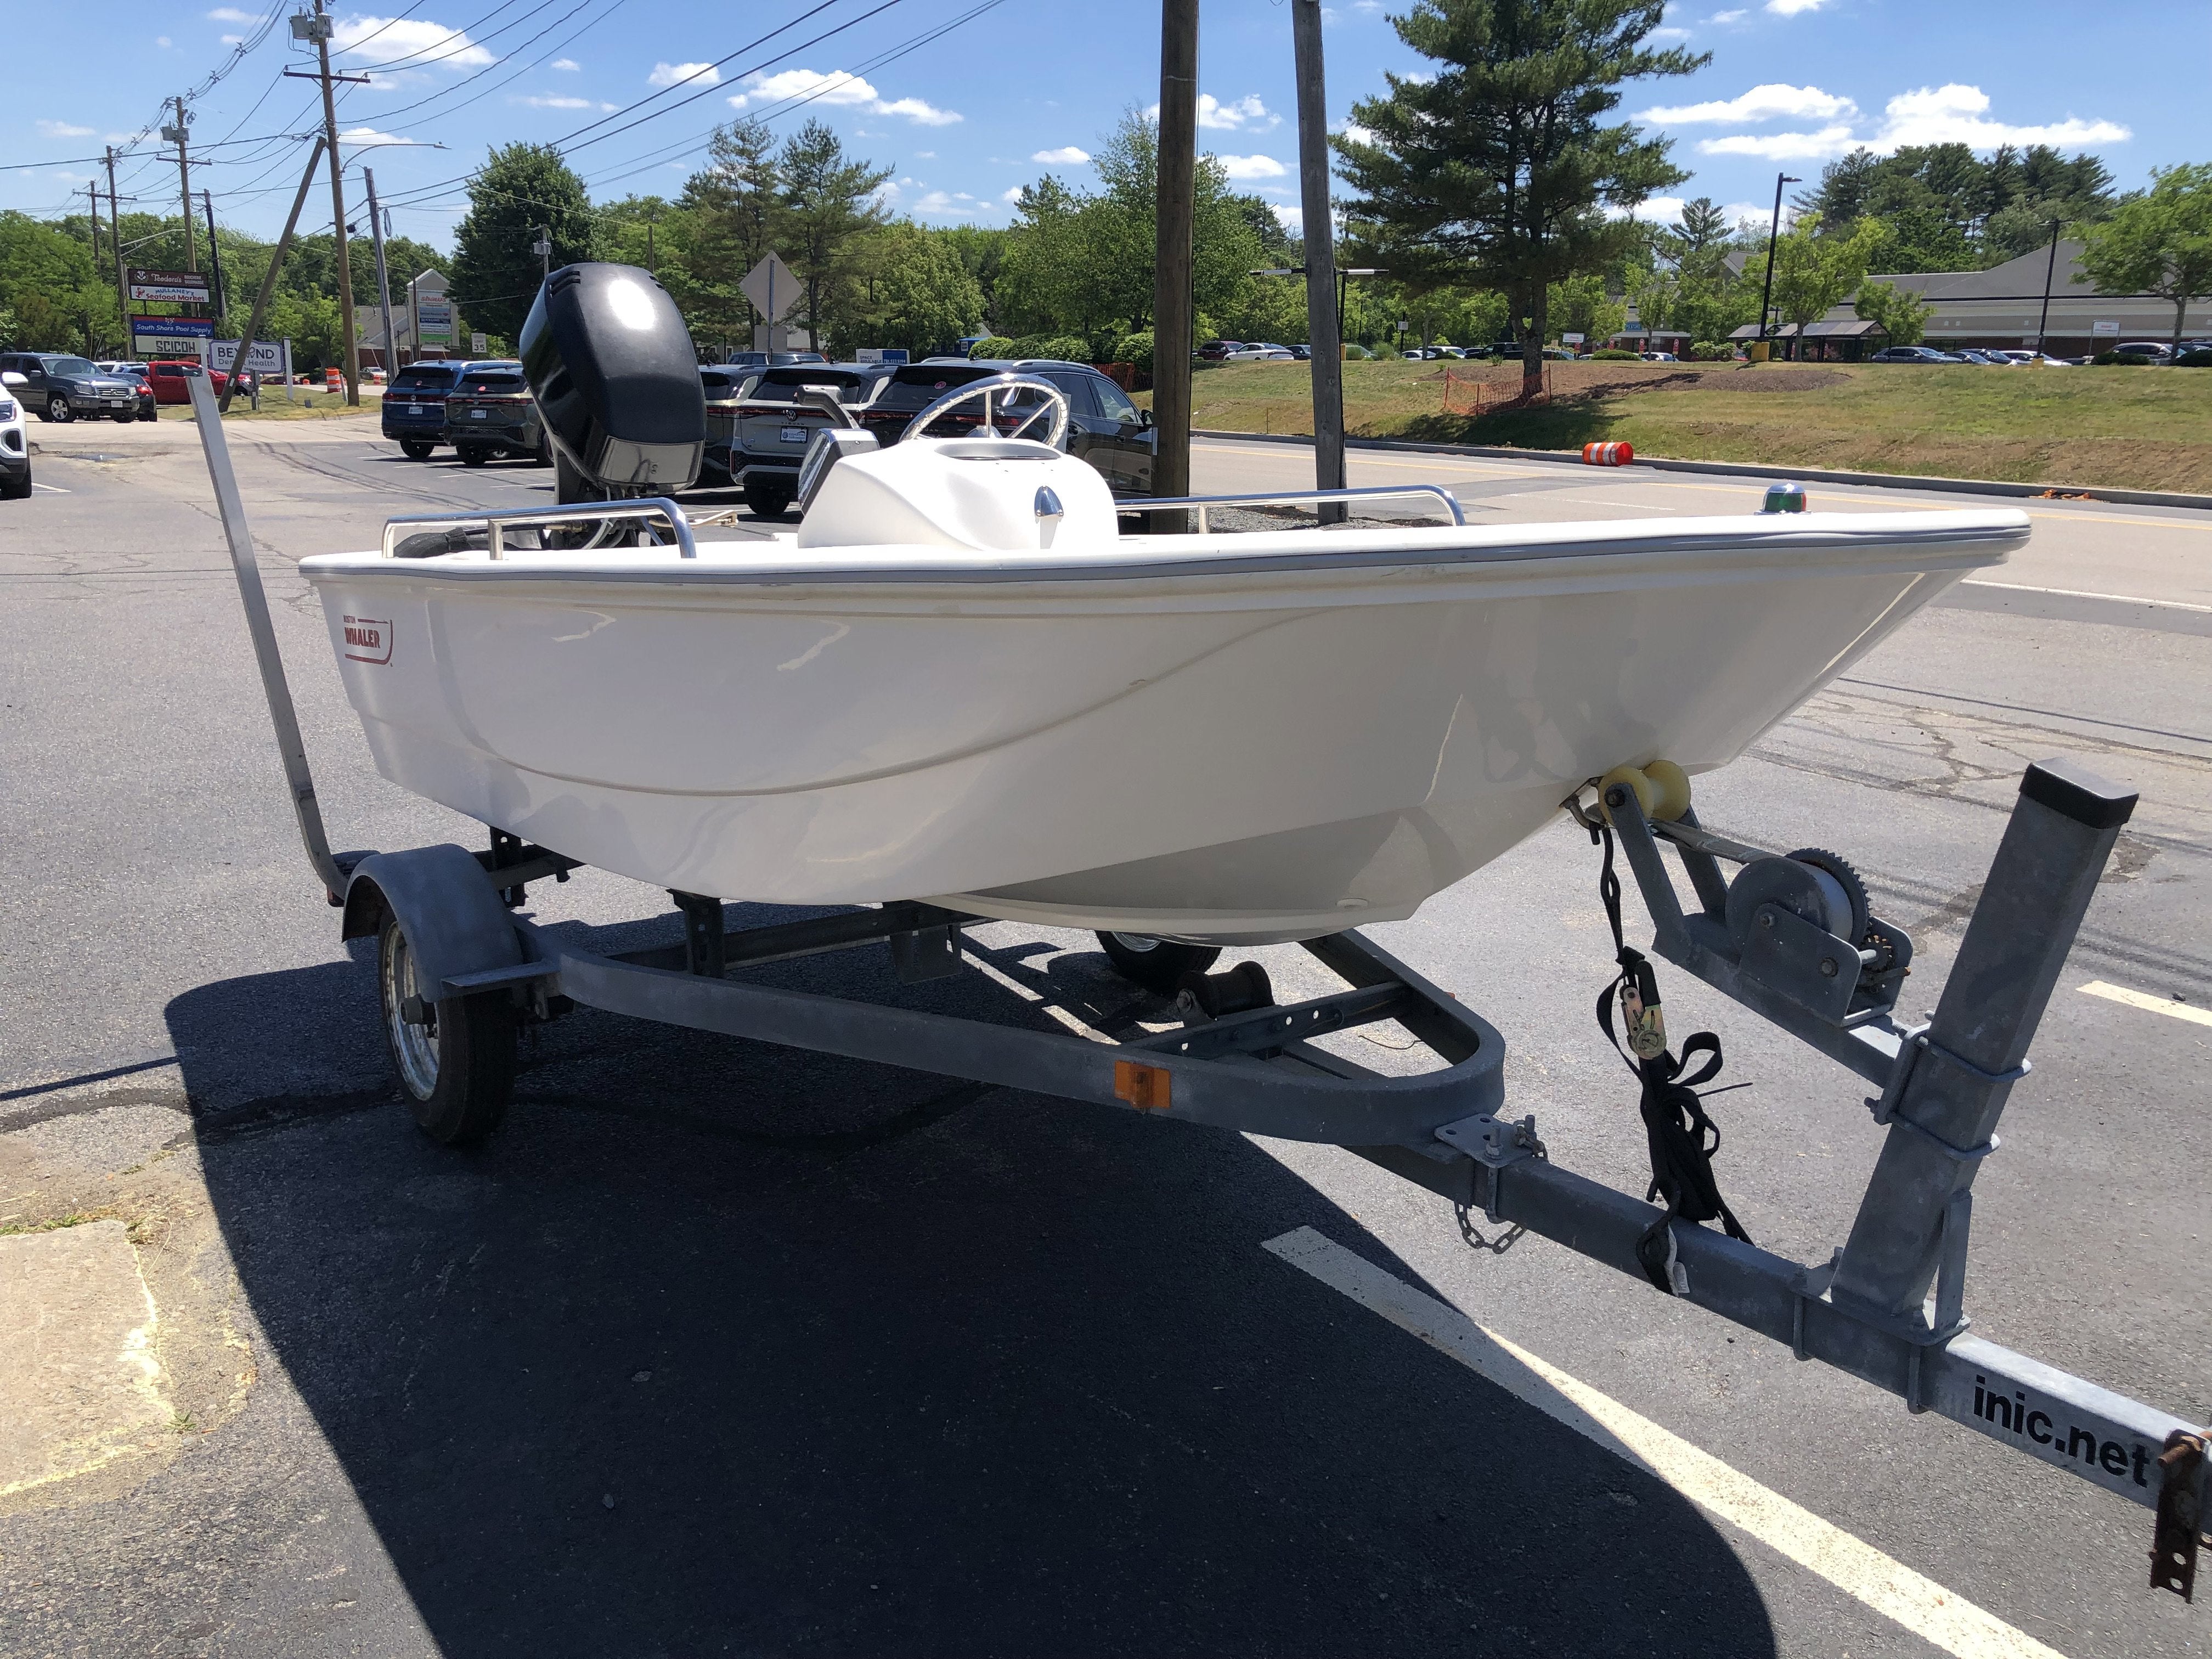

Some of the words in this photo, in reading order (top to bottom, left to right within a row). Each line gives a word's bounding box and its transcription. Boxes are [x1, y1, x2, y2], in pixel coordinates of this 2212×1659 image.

[151, 273, 182, 283] Teodora's
[190, 326, 211, 335] Supply
[344, 627, 381, 649] WHALER
[1973, 1374, 2151, 1488] inic.net
